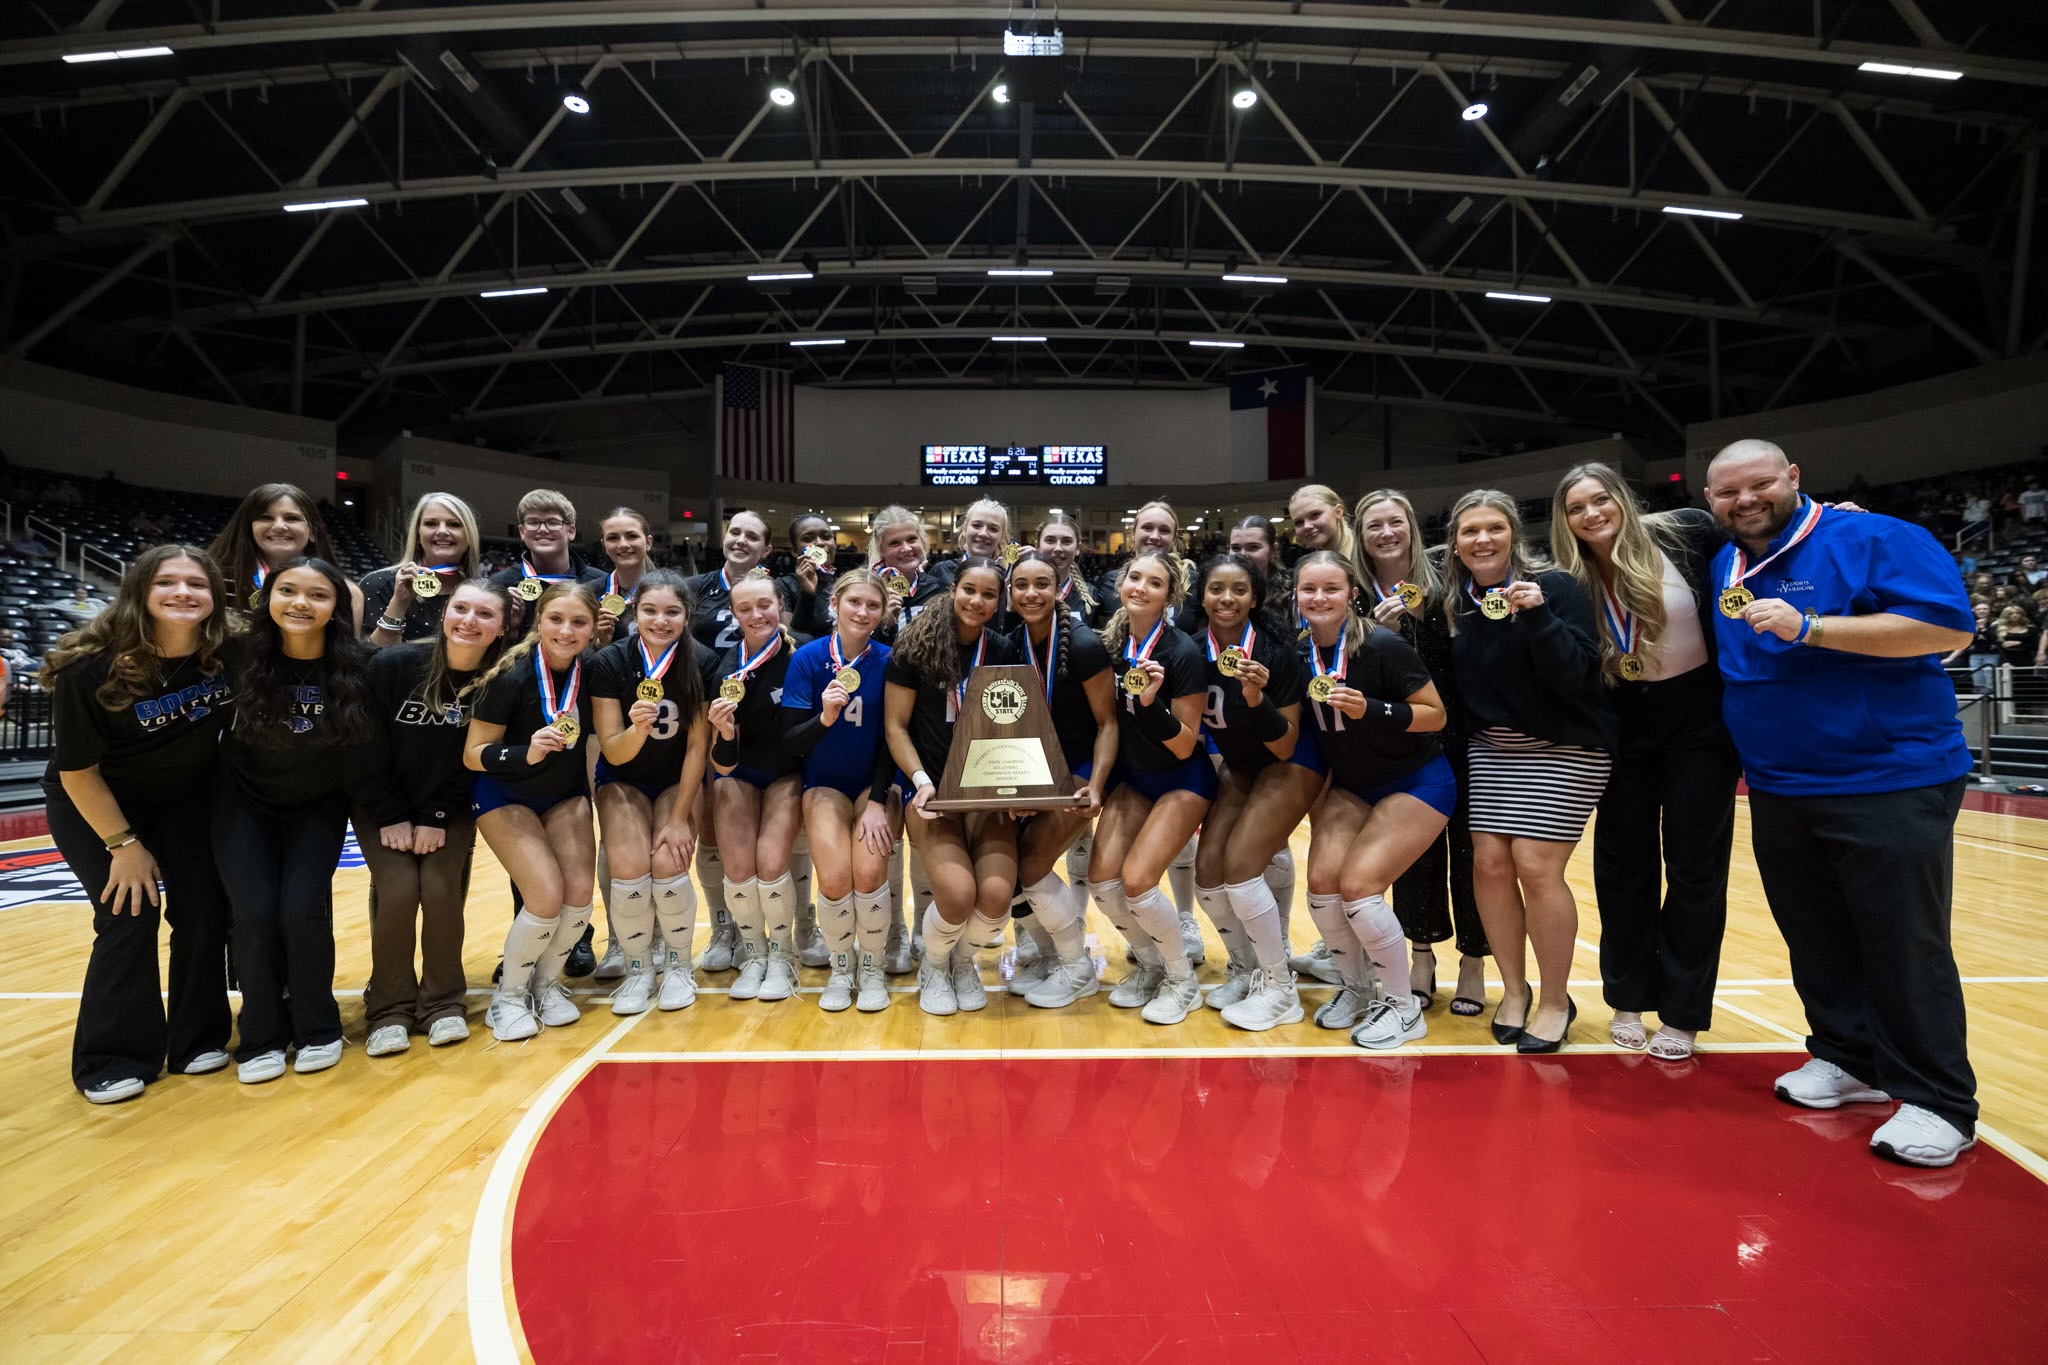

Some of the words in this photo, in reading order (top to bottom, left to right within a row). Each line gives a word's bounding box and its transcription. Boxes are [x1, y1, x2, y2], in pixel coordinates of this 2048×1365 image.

[298, 447, 327, 459] 105
[942, 451, 986, 463] TEXAS
[1060, 451, 1103, 463] TEXAS
[932, 475, 978, 485] CUTX.ORG
[1050, 475, 1096, 485] CUTX.ORG
[417, 580, 436, 590] UIL
[1486, 599, 1507, 610] UIL
[1724, 594, 1747, 610] UIL
[714, 609, 741, 648] 2
[1222, 655, 1238, 670] UIL
[1128, 674, 1144, 687] UIL
[641, 684, 659, 698] UIL
[990, 688, 1019, 708] UIL
[844, 696, 863, 727] 4
[1202, 685, 1228, 729] 9
[649, 699, 679, 740] 3
